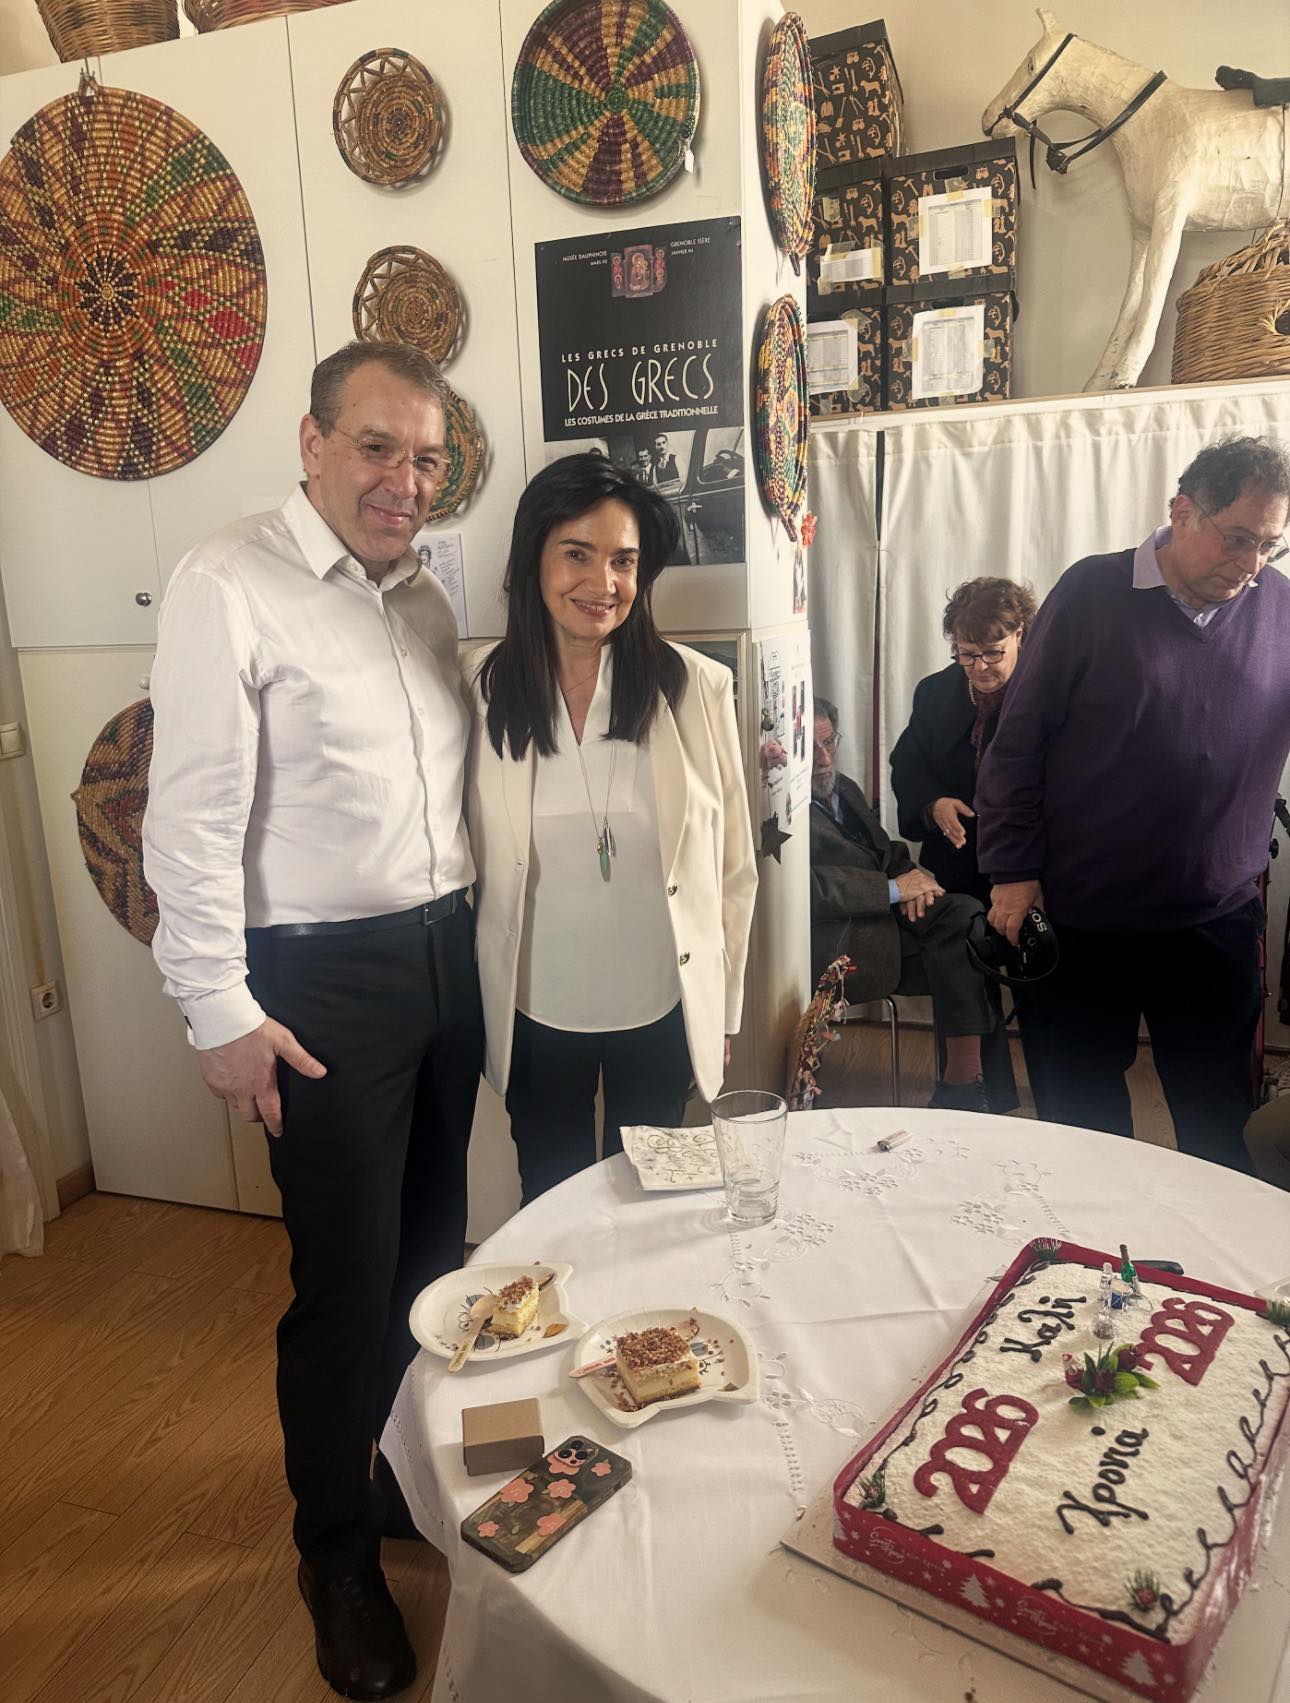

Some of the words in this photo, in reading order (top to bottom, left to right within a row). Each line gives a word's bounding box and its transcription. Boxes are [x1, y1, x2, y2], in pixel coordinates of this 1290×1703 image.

[671, 239, 696, 248] GRENOBLE
[697, 236, 711, 245] ISÈRE
[562, 254, 577, 262] MUSÉE
[561, 353, 580, 363] LES
[588, 348, 624, 360] GRECS
[632, 346, 646, 356] DE
[654, 338, 718, 353] GRENOBLE
[567, 363, 608, 413] DES
[631, 353, 714, 405] GRECS
[564, 417, 577, 427] LES
[577, 413, 614, 426] COSTUMES
[615, 413, 625, 422] DE
[625, 411, 635, 421] LA
[635, 409, 658, 421] GRÈCE
[659, 405, 719, 419] TRADITIONNELLE
[1137, 1297, 1236, 1387] 2026
[914, 1387, 1040, 1515] 2026
